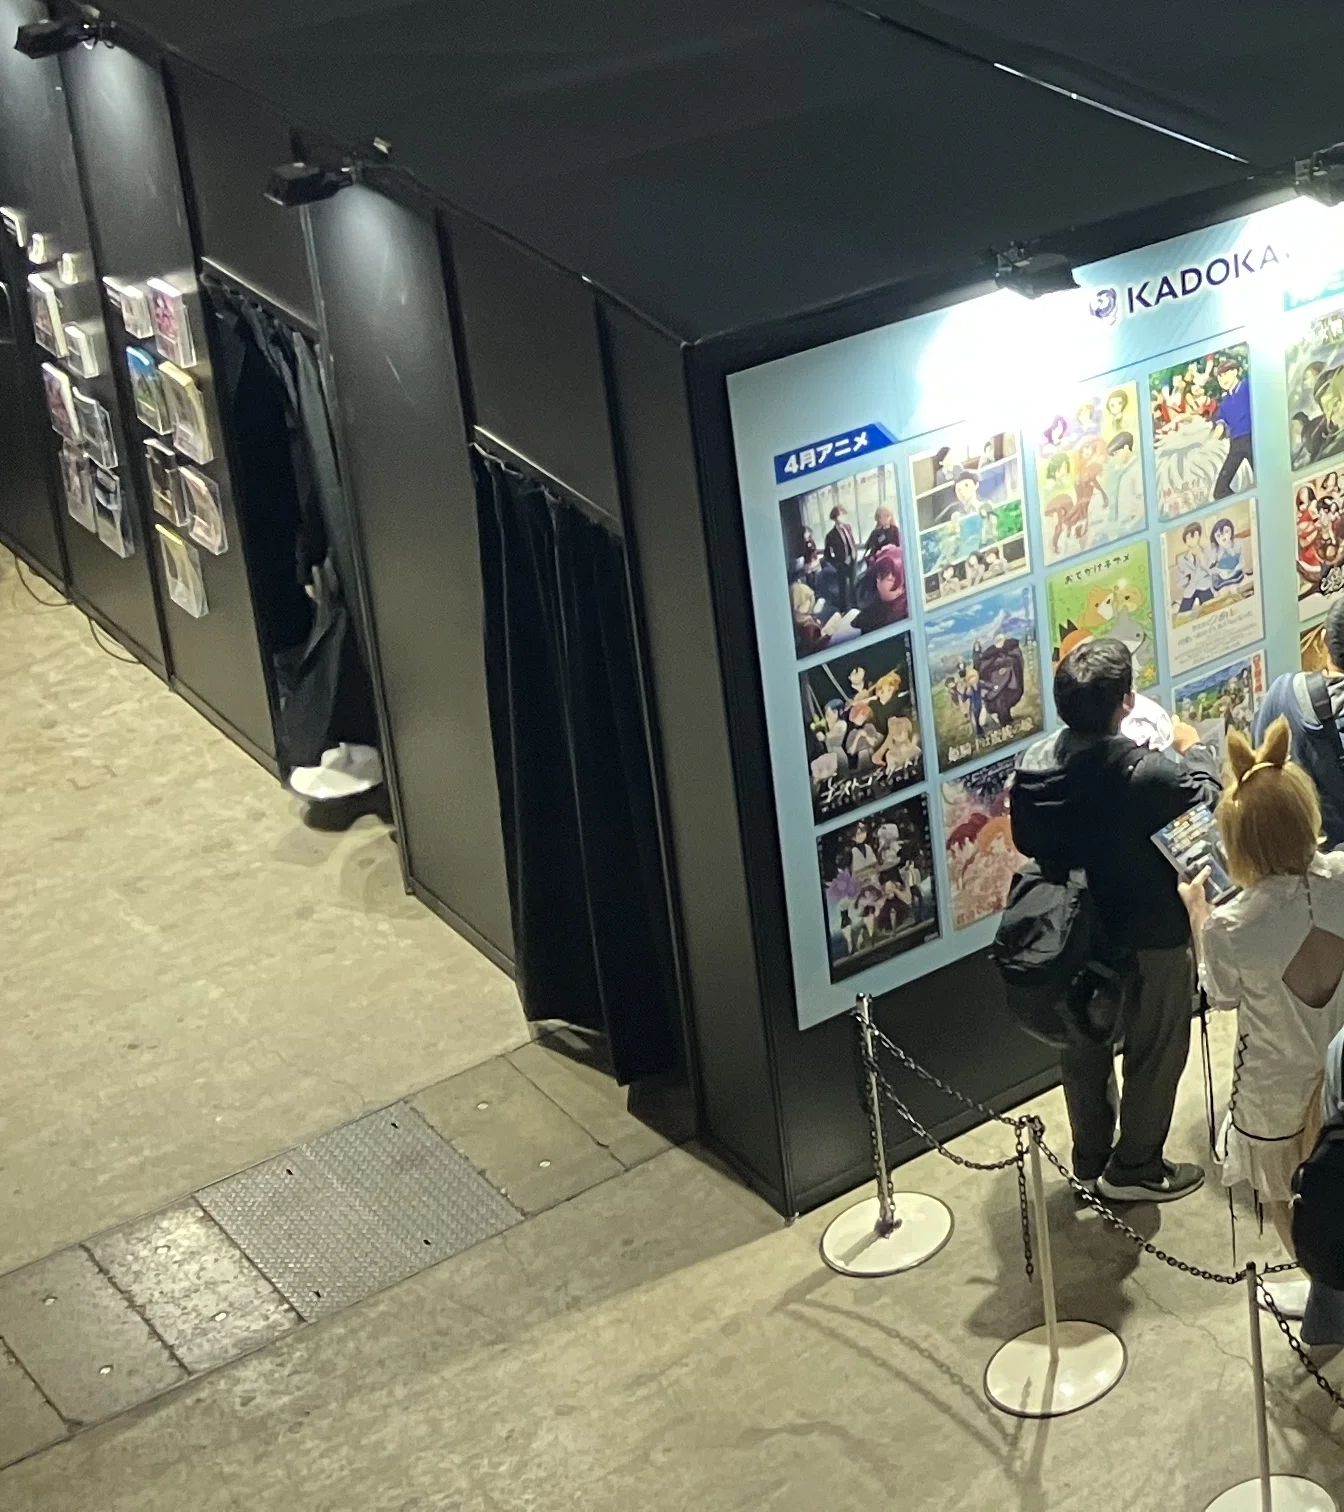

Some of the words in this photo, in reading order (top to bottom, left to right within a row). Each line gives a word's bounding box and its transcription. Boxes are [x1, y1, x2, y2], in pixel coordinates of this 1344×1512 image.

[1127, 244, 1290, 314] KADOKA
[783, 431, 868, 474] 4月アニメ
